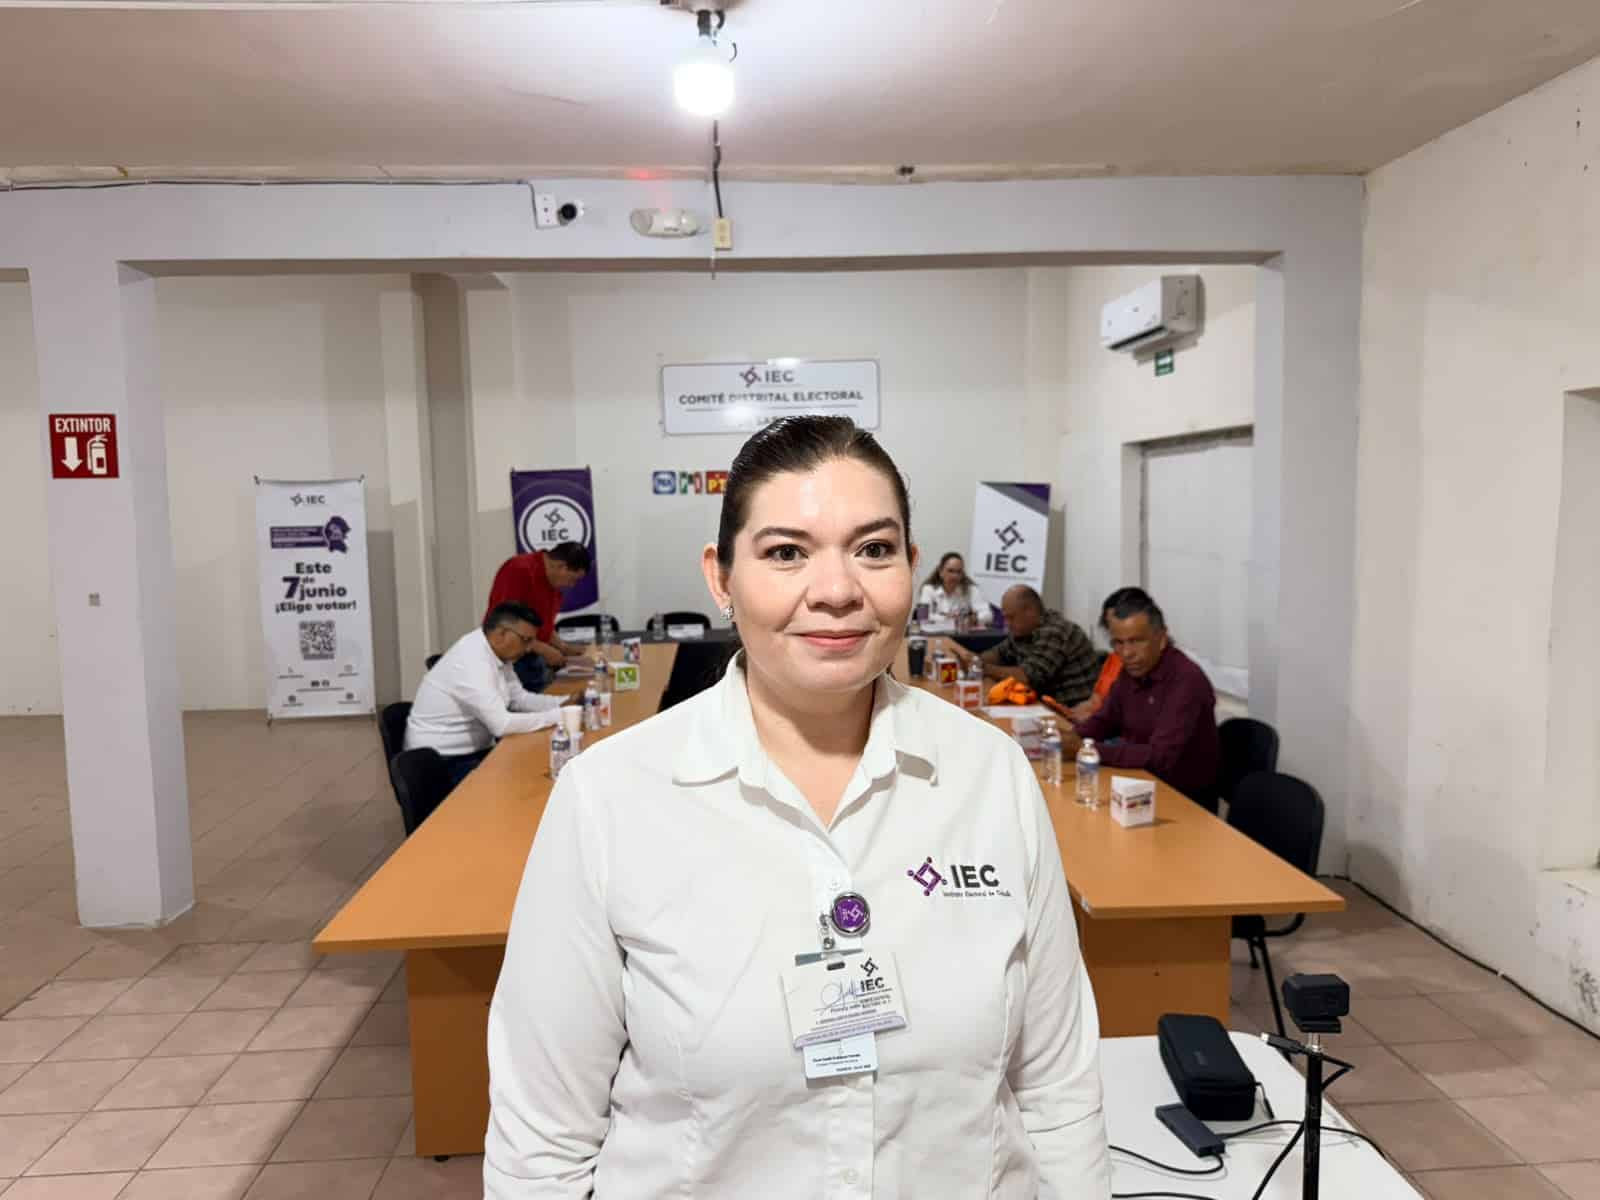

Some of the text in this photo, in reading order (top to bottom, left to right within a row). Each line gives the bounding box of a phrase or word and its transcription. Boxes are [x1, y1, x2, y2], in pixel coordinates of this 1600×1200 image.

[764, 369, 795, 383] IEC
[679, 391, 725, 406] COMITÉ
[793, 390, 864, 402] ELECTORAL
[55, 417, 111, 433] EXTINTOR
[306, 495, 326, 505] IEC
[541, 528, 569, 542] IEC
[295, 562, 332, 575] Este
[985, 552, 1028, 573] IEC
[282, 576, 300, 599] 7
[300, 583, 347, 601] junio
[275, 600, 357, 614] ¡Elige votar!
[950, 864, 1000, 888] IEC
[860, 976, 885, 992] IEC
